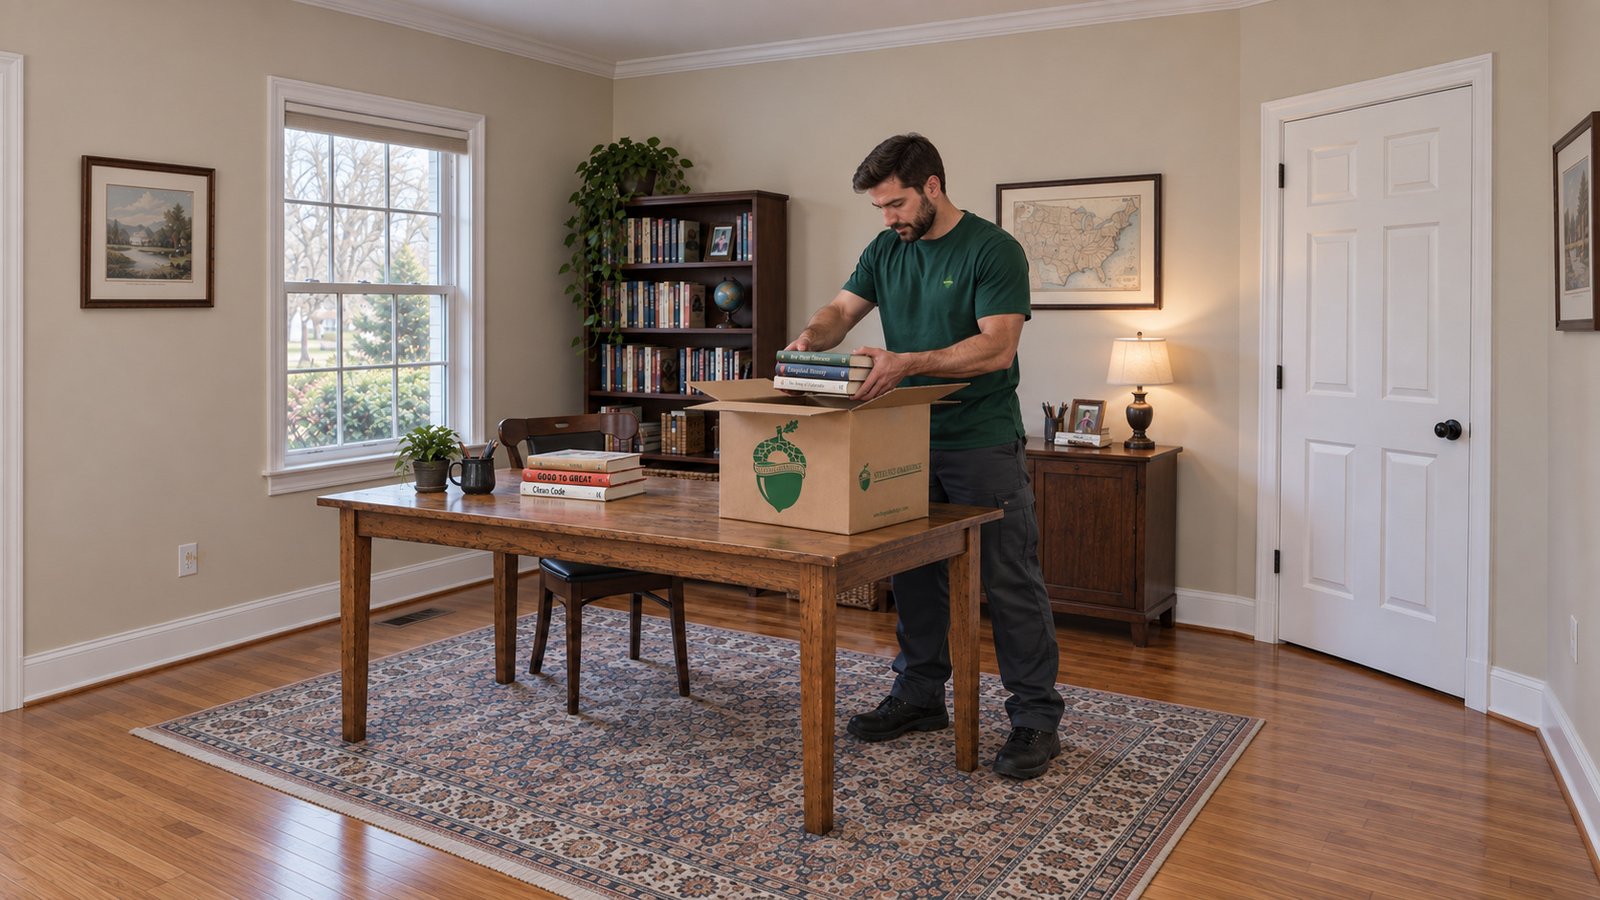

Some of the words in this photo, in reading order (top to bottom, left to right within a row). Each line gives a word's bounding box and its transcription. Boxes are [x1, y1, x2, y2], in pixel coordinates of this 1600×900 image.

[559, 474, 568, 482] TO
[569, 474, 592, 483] GREAT
[550, 487, 566, 495] Code
